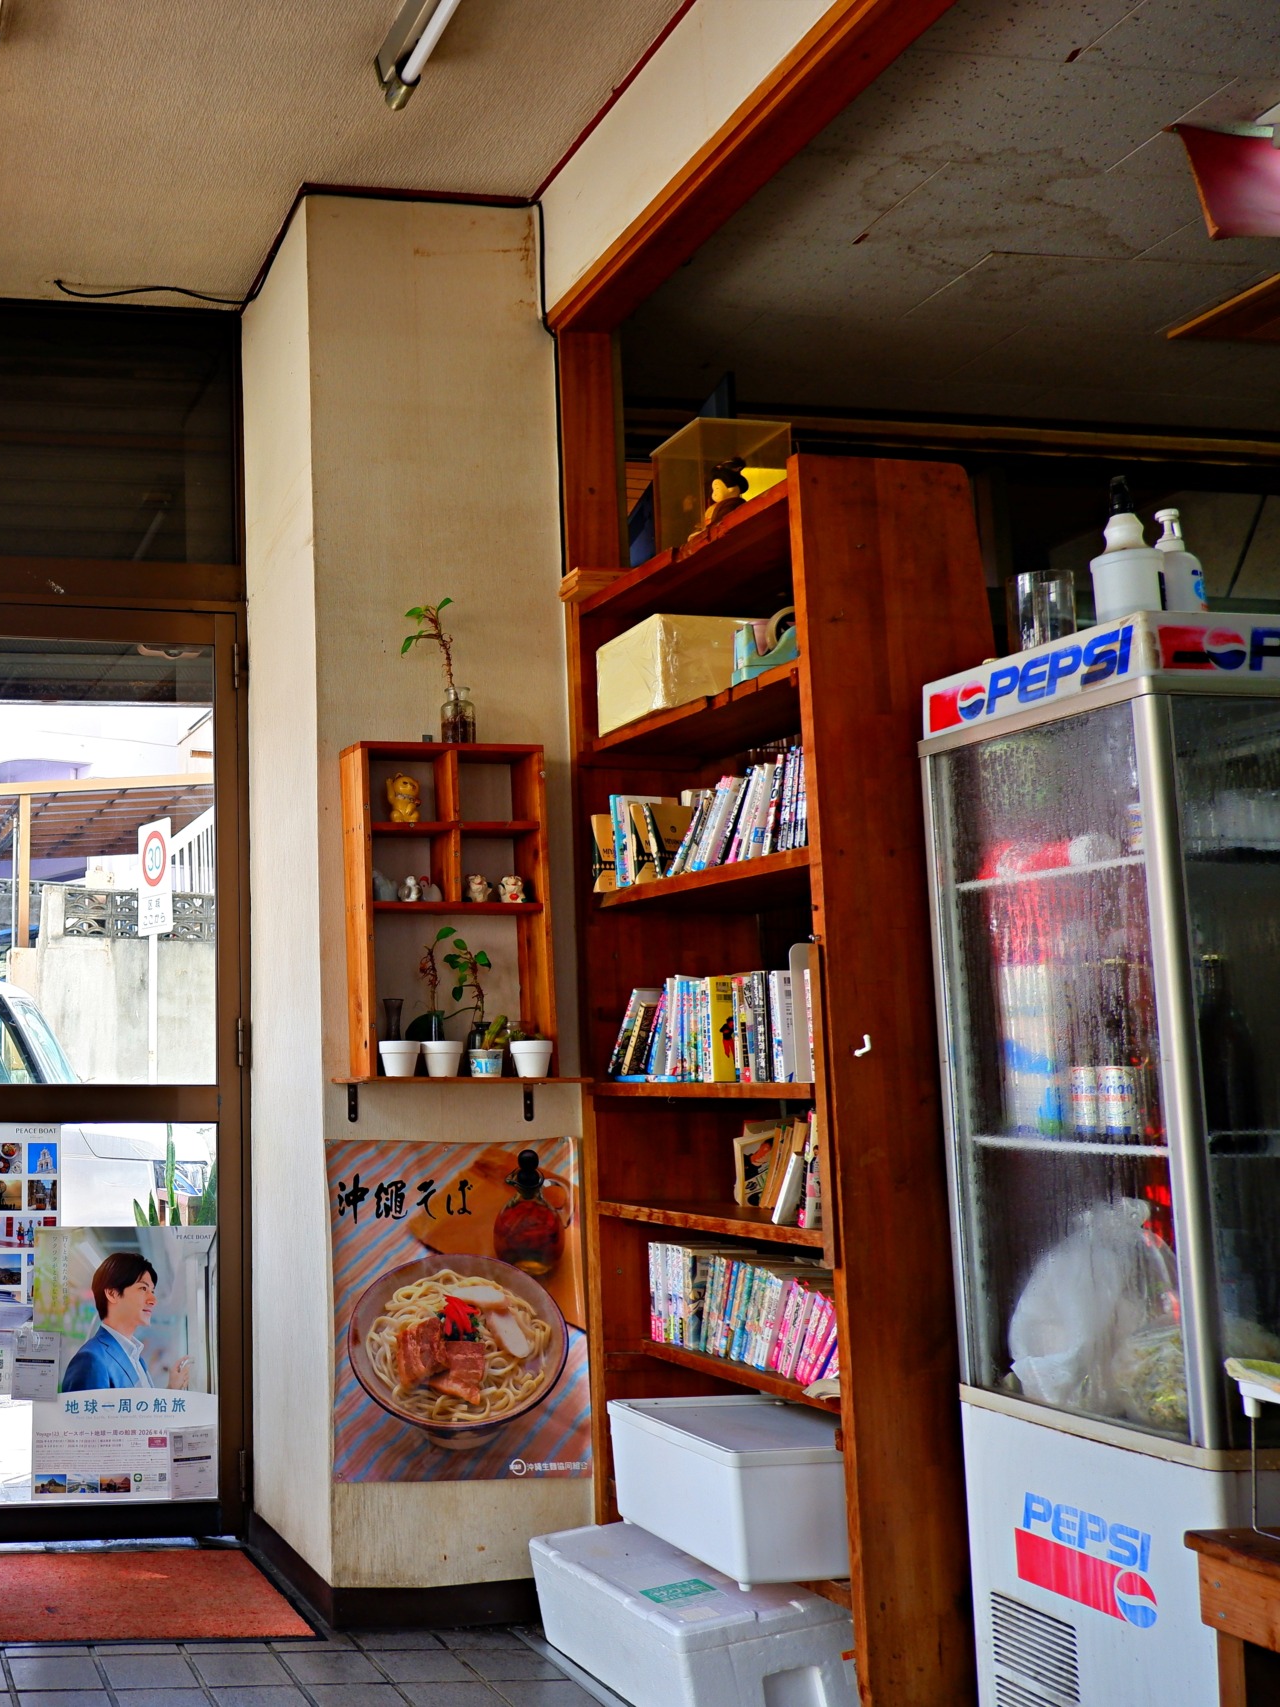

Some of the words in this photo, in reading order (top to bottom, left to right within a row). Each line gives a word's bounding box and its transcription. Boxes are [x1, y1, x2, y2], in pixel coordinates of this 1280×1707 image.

[986, 625, 1133, 715] PEPSI
[148, 845, 161, 872] 30
[65, 1398, 186, 1414] 地球一周の船旅
[1023, 1491, 1151, 1573] PEPSI
